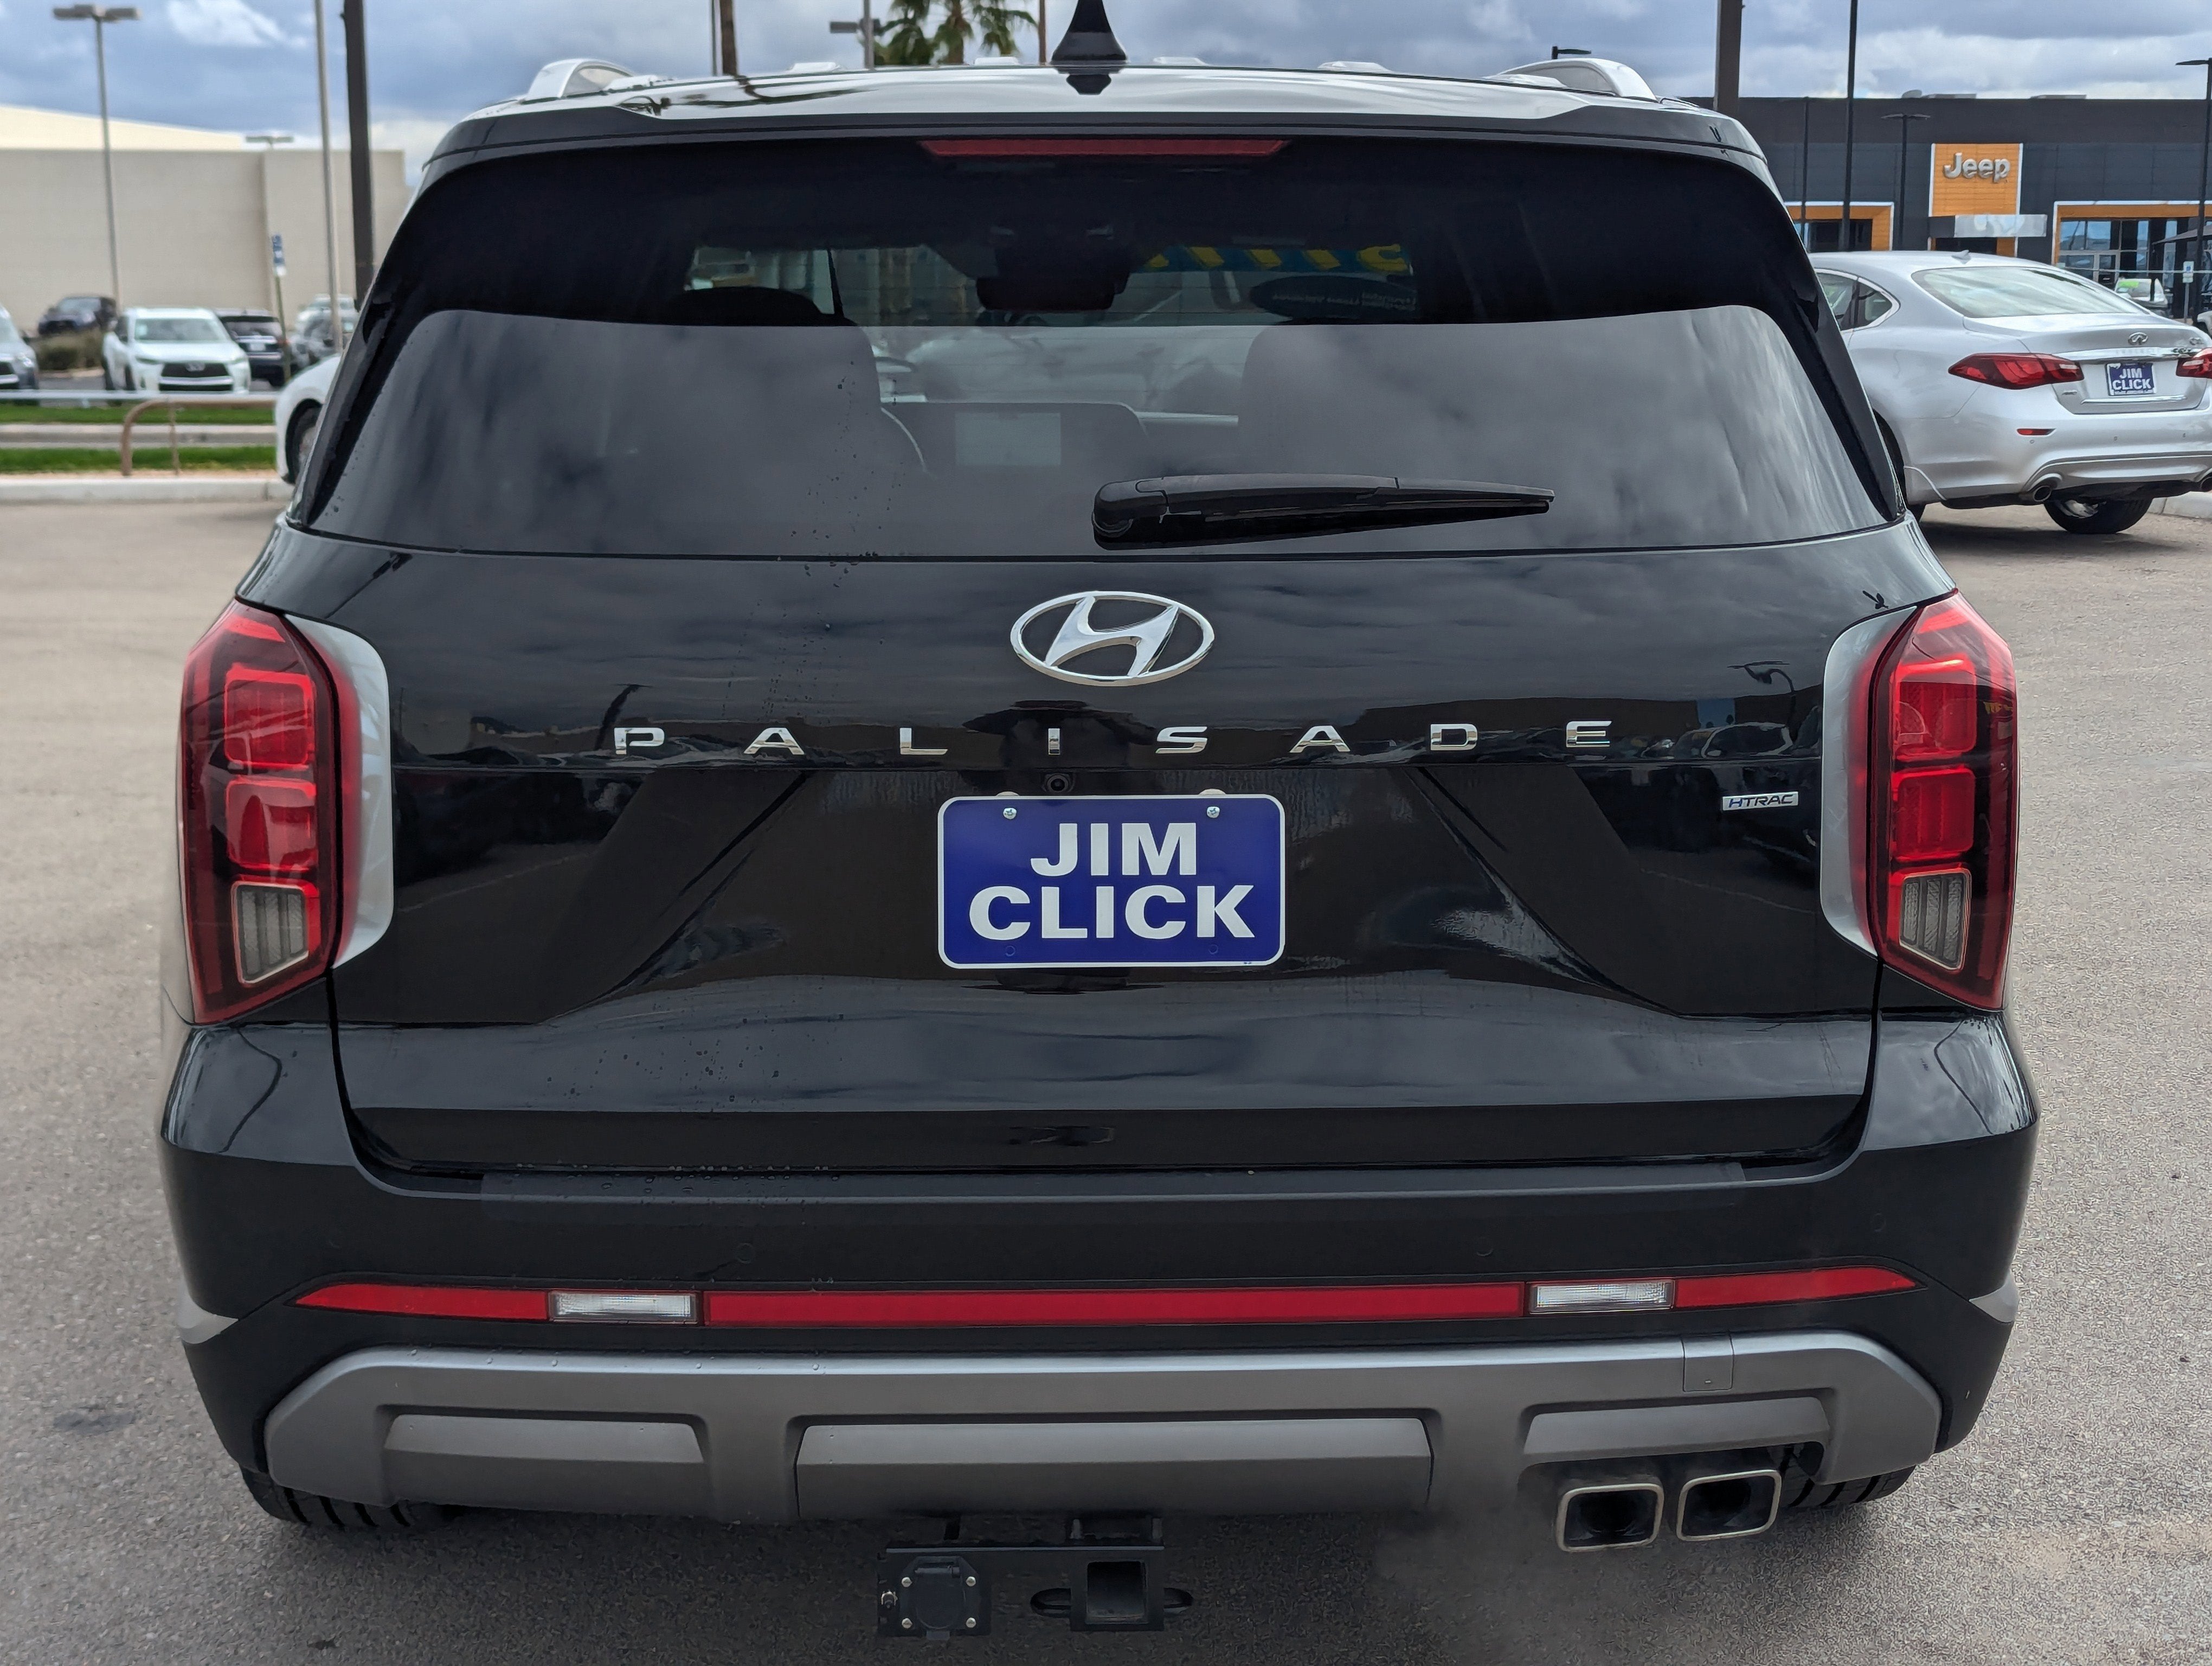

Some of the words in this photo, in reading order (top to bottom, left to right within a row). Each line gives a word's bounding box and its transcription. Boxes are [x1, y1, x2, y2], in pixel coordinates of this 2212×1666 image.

[1944, 152, 2011, 183] Jeep
[2112, 379, 2152, 390] CLICK
[2119, 368, 2142, 379] JIM
[614, 720, 1612, 755] PALISADE
[1728, 794, 1793, 808] HTRAC
[1031, 823, 1197, 876] JIM
[969, 885, 1255, 940] CLICK
